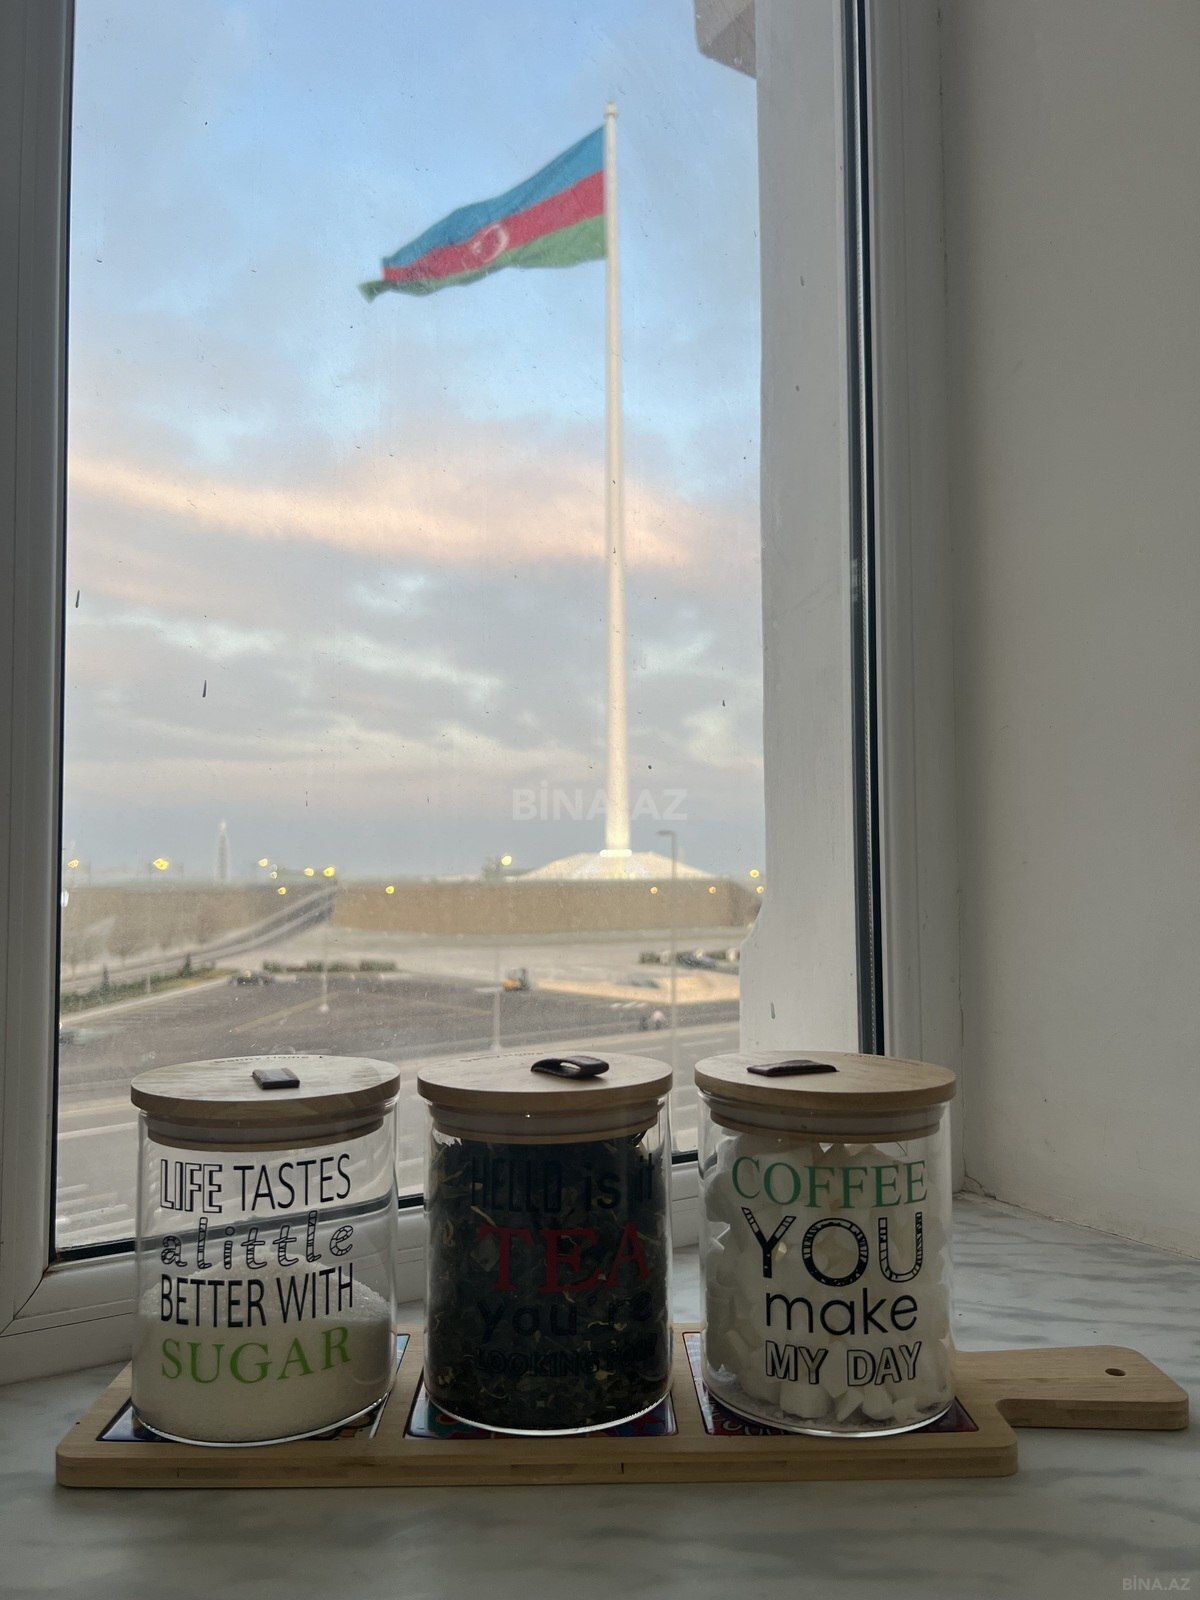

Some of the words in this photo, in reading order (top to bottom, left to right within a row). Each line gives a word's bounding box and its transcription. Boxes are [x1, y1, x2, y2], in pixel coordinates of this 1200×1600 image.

[160, 1158, 223, 1214] LIFE
[233, 1153, 351, 1211] TASTES
[583, 1160, 621, 1211] is
[731, 1156, 928, 1209] COFFEE
[475, 1221, 652, 1294] TEA
[741, 1206, 923, 1287] YOU
[160, 1273, 267, 1328] BETTER
[276, 1262, 353, 1324] WITH
[766, 1287, 918, 1336] make
[161, 1326, 351, 1384] SUGAR
[765, 1340, 828, 1385] MY
[847, 1341, 922, 1387] DAY
